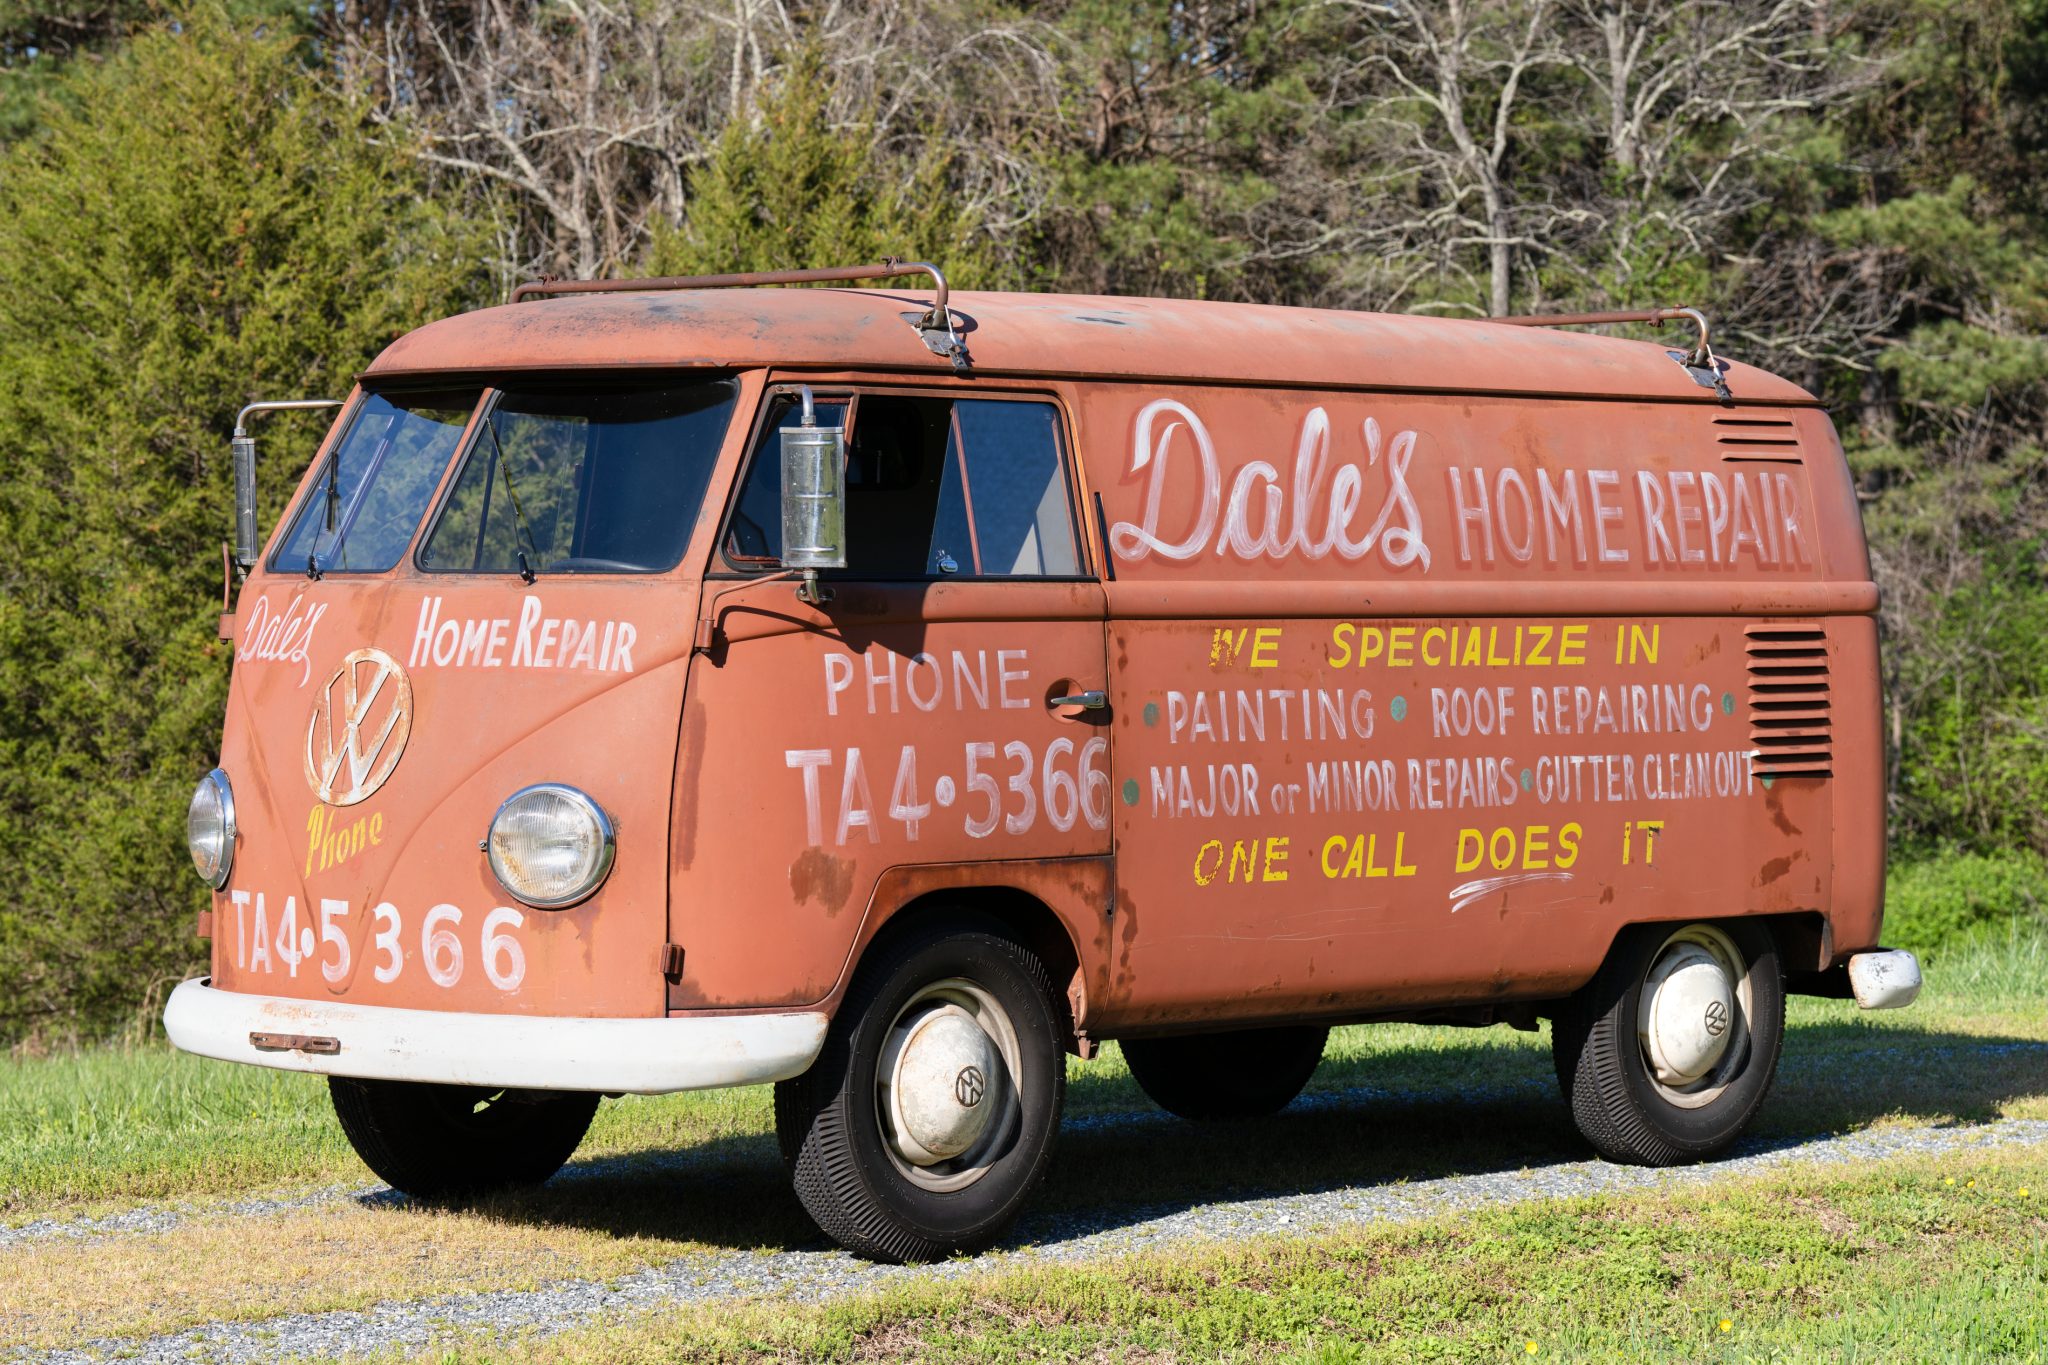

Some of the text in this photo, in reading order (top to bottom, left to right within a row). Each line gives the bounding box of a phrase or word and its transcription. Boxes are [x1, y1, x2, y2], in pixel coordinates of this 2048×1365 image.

[1110, 398, 1811, 574] Dale's HOME REPAIR
[239, 594, 328, 688] Dale's
[408, 594, 637, 673] HOME REPAIR
[1208, 622, 1660, 669] WE SPECIALIZE IN
[824, 649, 1030, 716] PHONE
[1167, 683, 1714, 744] PAINTING ROOF REPAIRING
[1150, 763, 1261, 819] MAJOR
[1270, 783, 1301, 815] or
[1306, 759, 1401, 815] MINOR
[1407, 756, 1519, 811] REPAIRS
[1536, 754, 1638, 804] GUTTER
[304, 803, 383, 880] Phone
[1194, 820, 1665, 887] ONE CALL DOES IT
